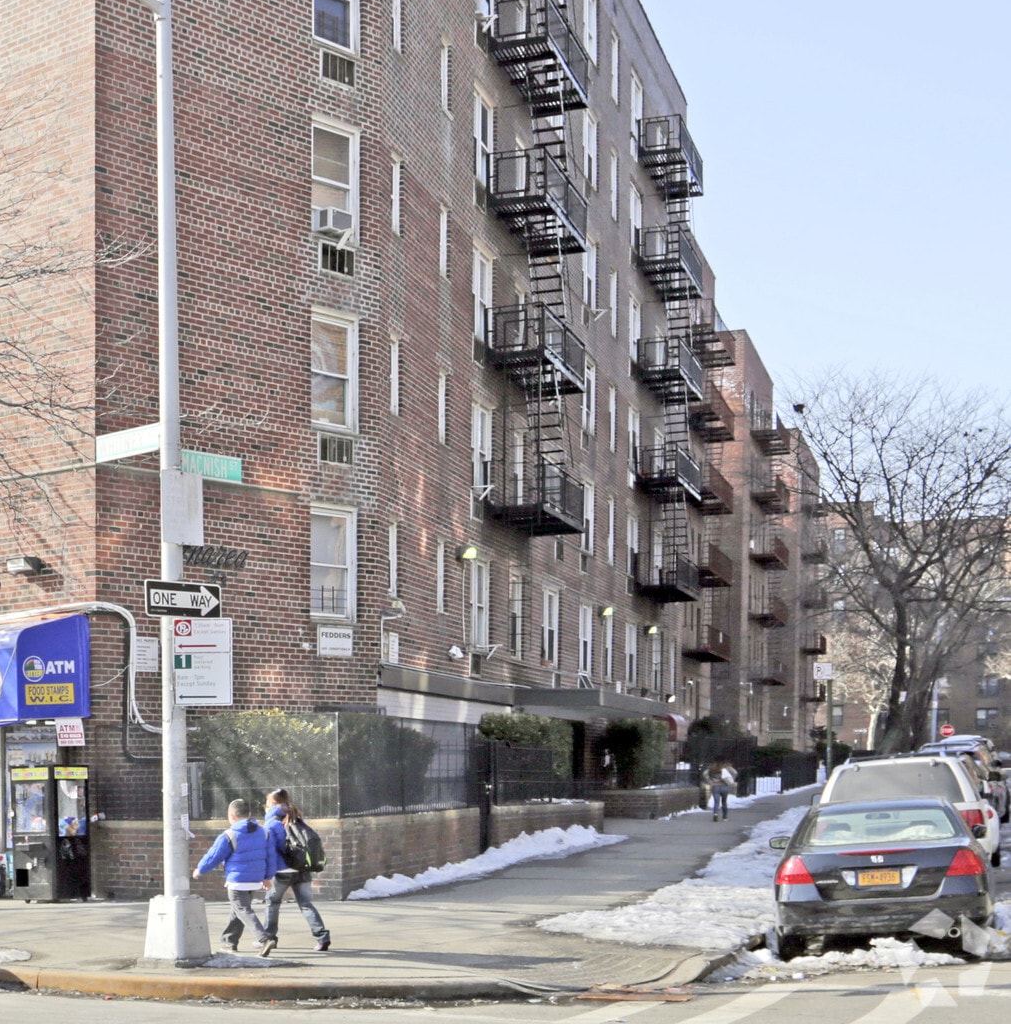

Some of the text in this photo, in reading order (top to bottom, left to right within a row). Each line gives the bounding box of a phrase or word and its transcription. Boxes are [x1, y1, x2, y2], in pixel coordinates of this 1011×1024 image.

[152, 591, 212, 608] ONE WAY
[321, 631, 351, 639] FEDDERS
[45, 660, 75, 675] ATM
[28, 685, 69, 696] FOOD STAMPS
